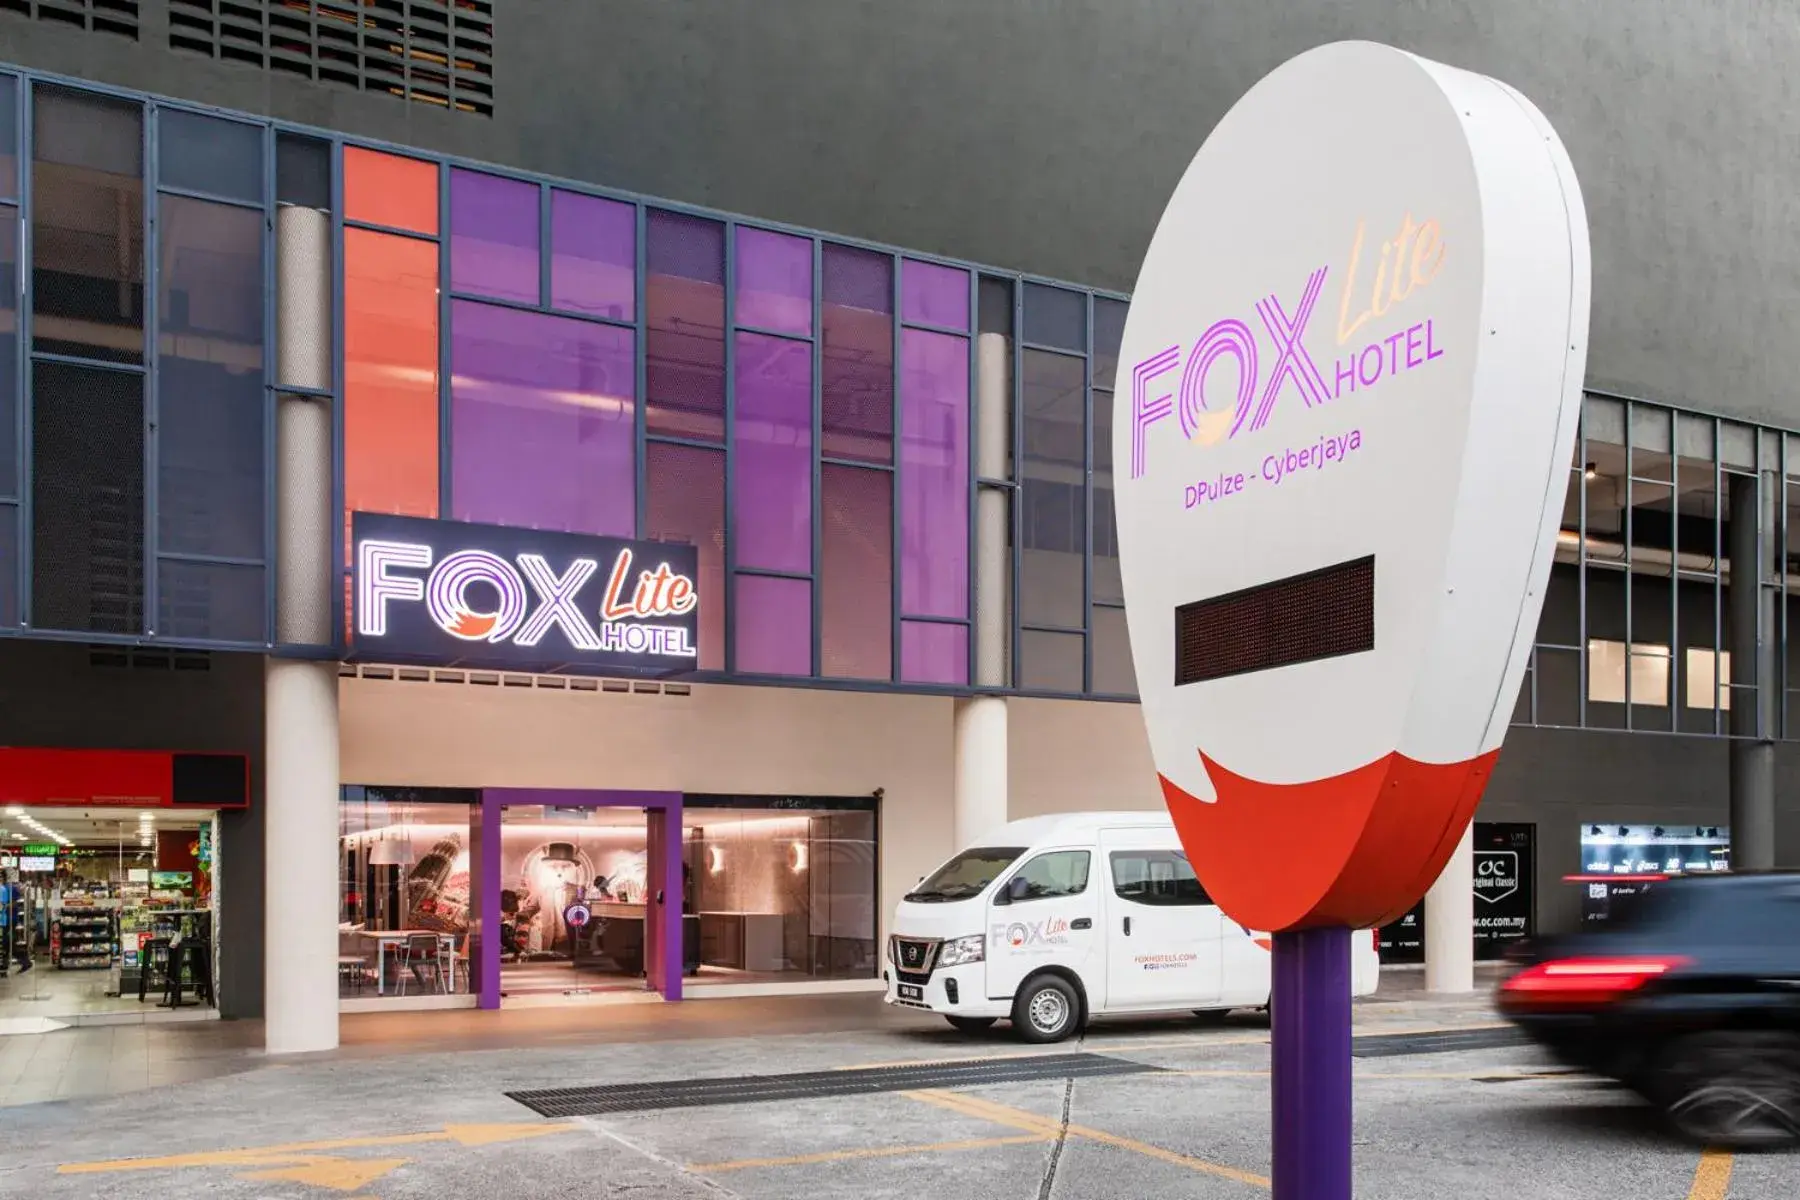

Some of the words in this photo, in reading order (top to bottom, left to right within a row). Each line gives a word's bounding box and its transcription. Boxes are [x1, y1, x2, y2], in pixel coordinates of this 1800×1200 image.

[1337, 211, 1446, 347] Lite
[1131, 264, 1333, 480] FOX
[1334, 319, 1444, 398] HOTEL
[1185, 472, 1245, 509] DPulze
[1262, 429, 1362, 485] Cyberjaya
[358, 539, 602, 650] FOX
[601, 548, 698, 620] Lite
[602, 621, 697, 657] HOTEL
[1473, 877, 1494, 888] riginal
[991, 921, 1046, 947] FOX
